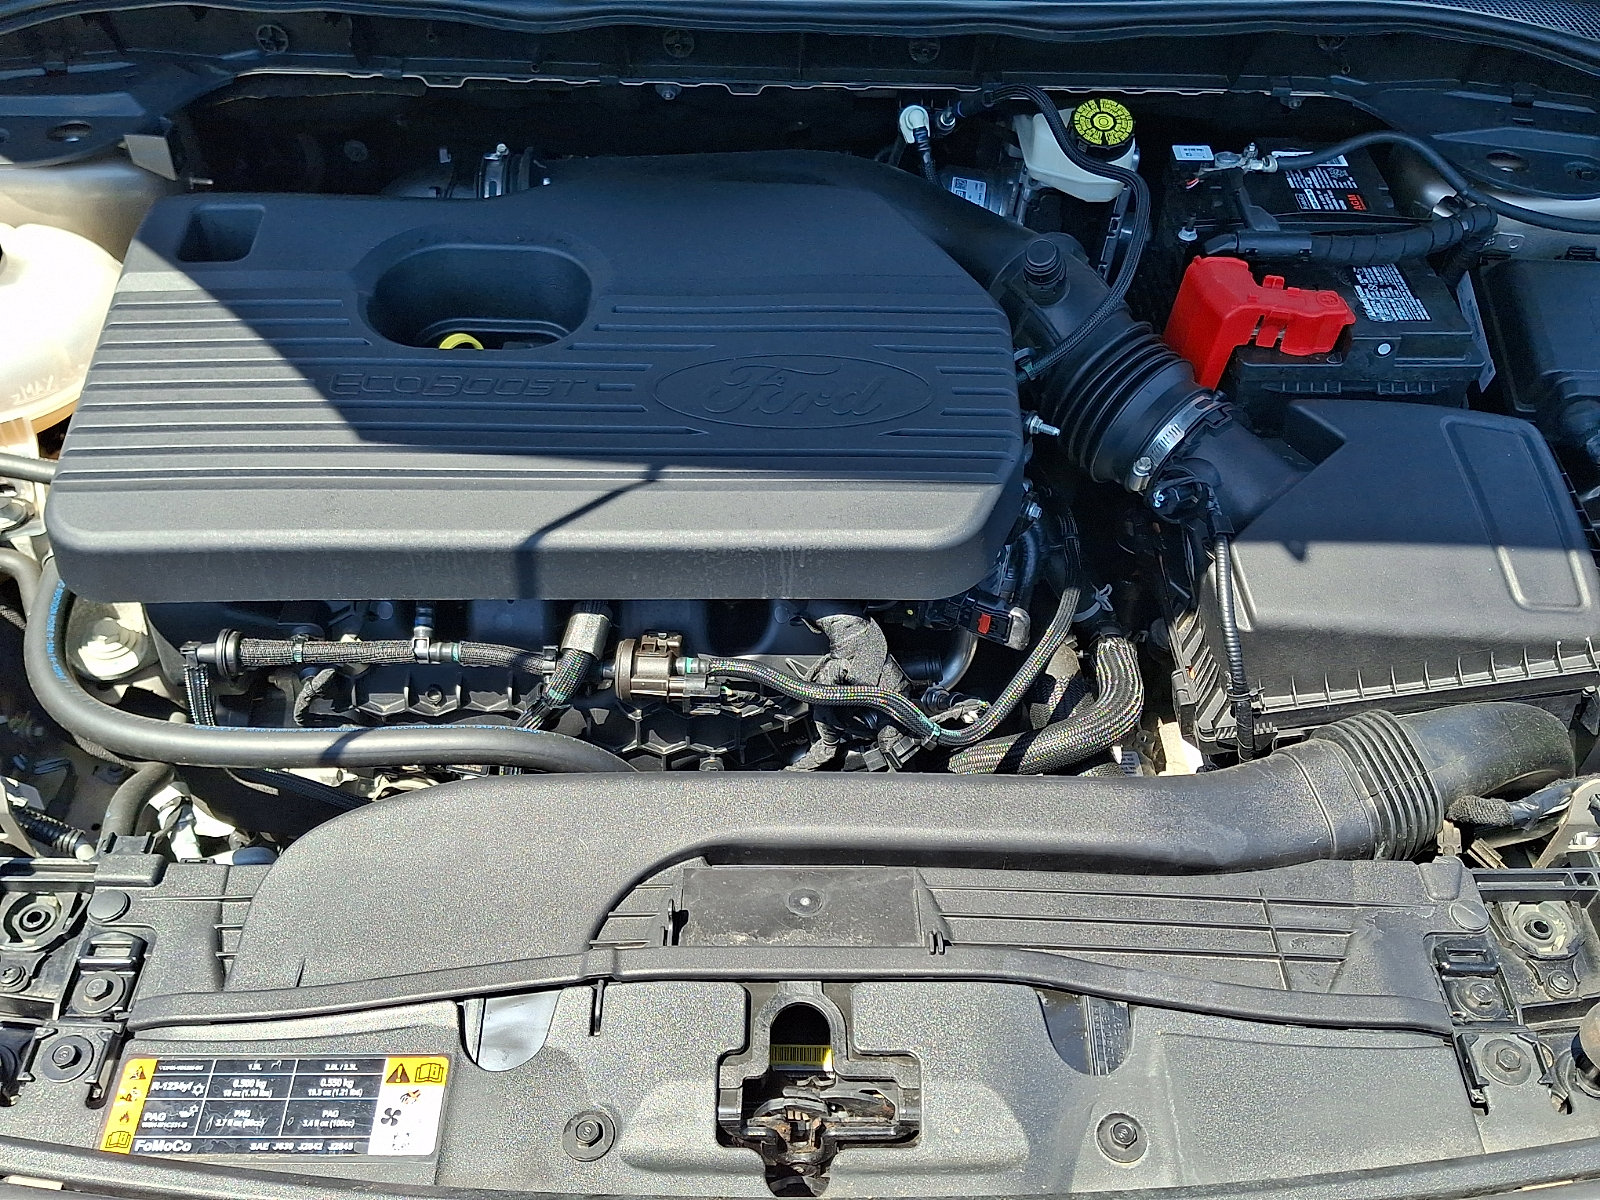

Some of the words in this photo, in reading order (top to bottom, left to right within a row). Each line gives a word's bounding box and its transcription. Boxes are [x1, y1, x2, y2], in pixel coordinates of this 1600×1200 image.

[1346, 194, 1363, 211] AGM
[703, 364, 888, 415] Ford
[143, 1112, 167, 1121] PAG
[322, 1110, 339, 1118] PAG
[134, 1140, 192, 1152] FoMoCo
[249, 1142, 270, 1150] SAE
